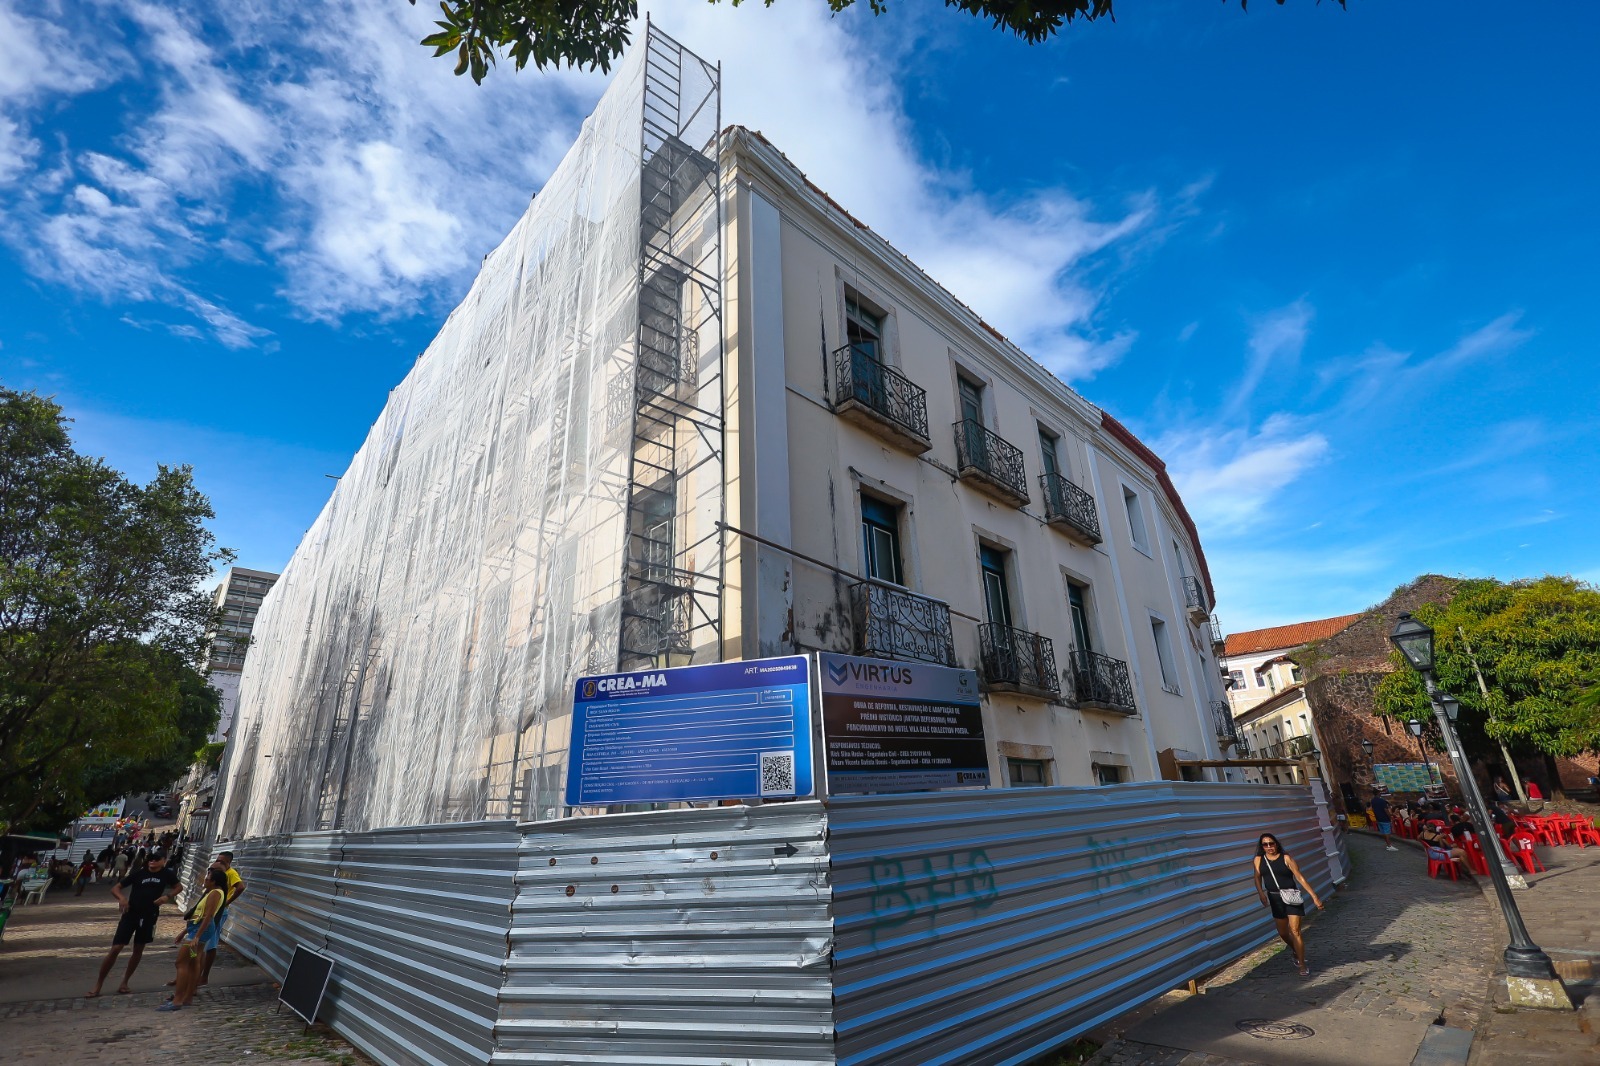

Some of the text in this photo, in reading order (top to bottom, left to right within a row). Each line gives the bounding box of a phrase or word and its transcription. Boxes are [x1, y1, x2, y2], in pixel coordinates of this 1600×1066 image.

[850, 662, 912, 684] VIRTUS
[598, 674, 667, 692] CREA-MA
[856, 683, 898, 692] ENGENHARIA
